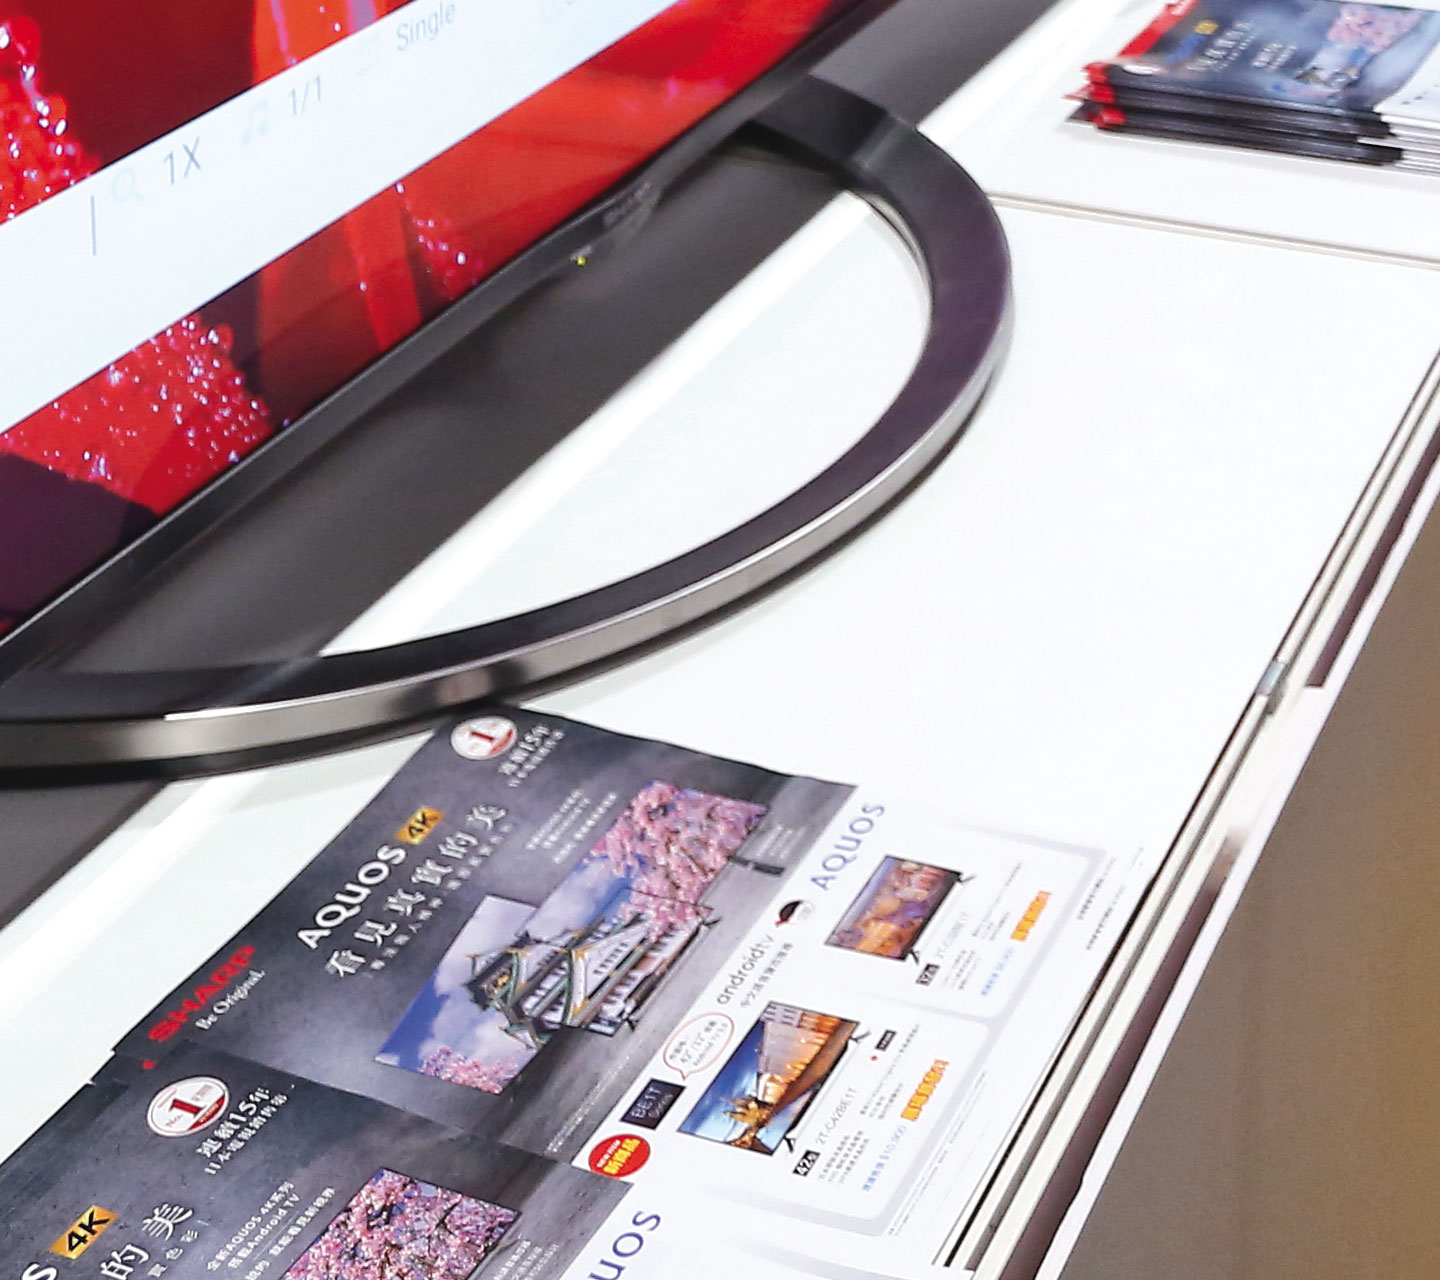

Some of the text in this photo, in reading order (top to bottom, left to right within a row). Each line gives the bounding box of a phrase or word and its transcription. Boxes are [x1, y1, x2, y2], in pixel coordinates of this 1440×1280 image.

[162, 137, 202, 187] 1X
[287, 75, 323, 117] 1/1
[395, 2, 457, 52] Single
[296, 811, 437, 950] AQUOS 4K
[811, 803, 886, 892] AQUOS
[148, 945, 256, 1042] SHARP
[603, 1138, 641, 1175] 新商品
[65, 1208, 110, 1253] 4K
